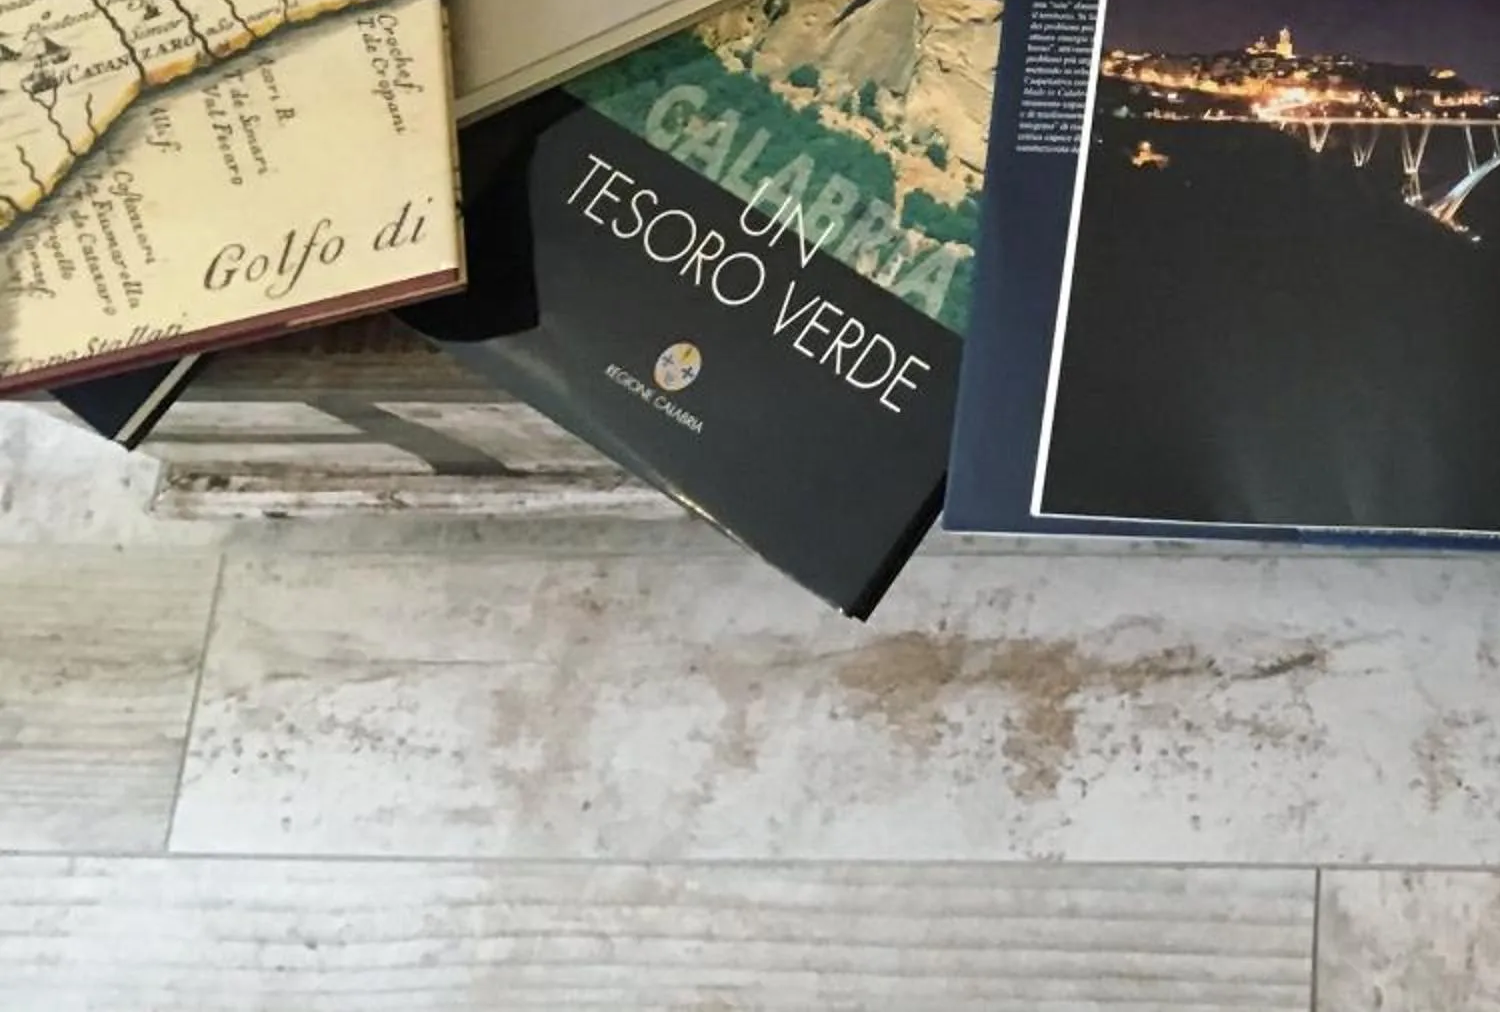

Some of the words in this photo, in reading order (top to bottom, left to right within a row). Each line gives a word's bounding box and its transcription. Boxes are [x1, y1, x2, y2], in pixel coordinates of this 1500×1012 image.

[203, 218, 346, 300] Golfo
[373, 197, 434, 252] di
[568, 153, 766, 306] TESORO
[773, 280, 931, 413] VERDE
[645, 85, 963, 318] CALABRIA
[740, 181, 835, 268] UN
